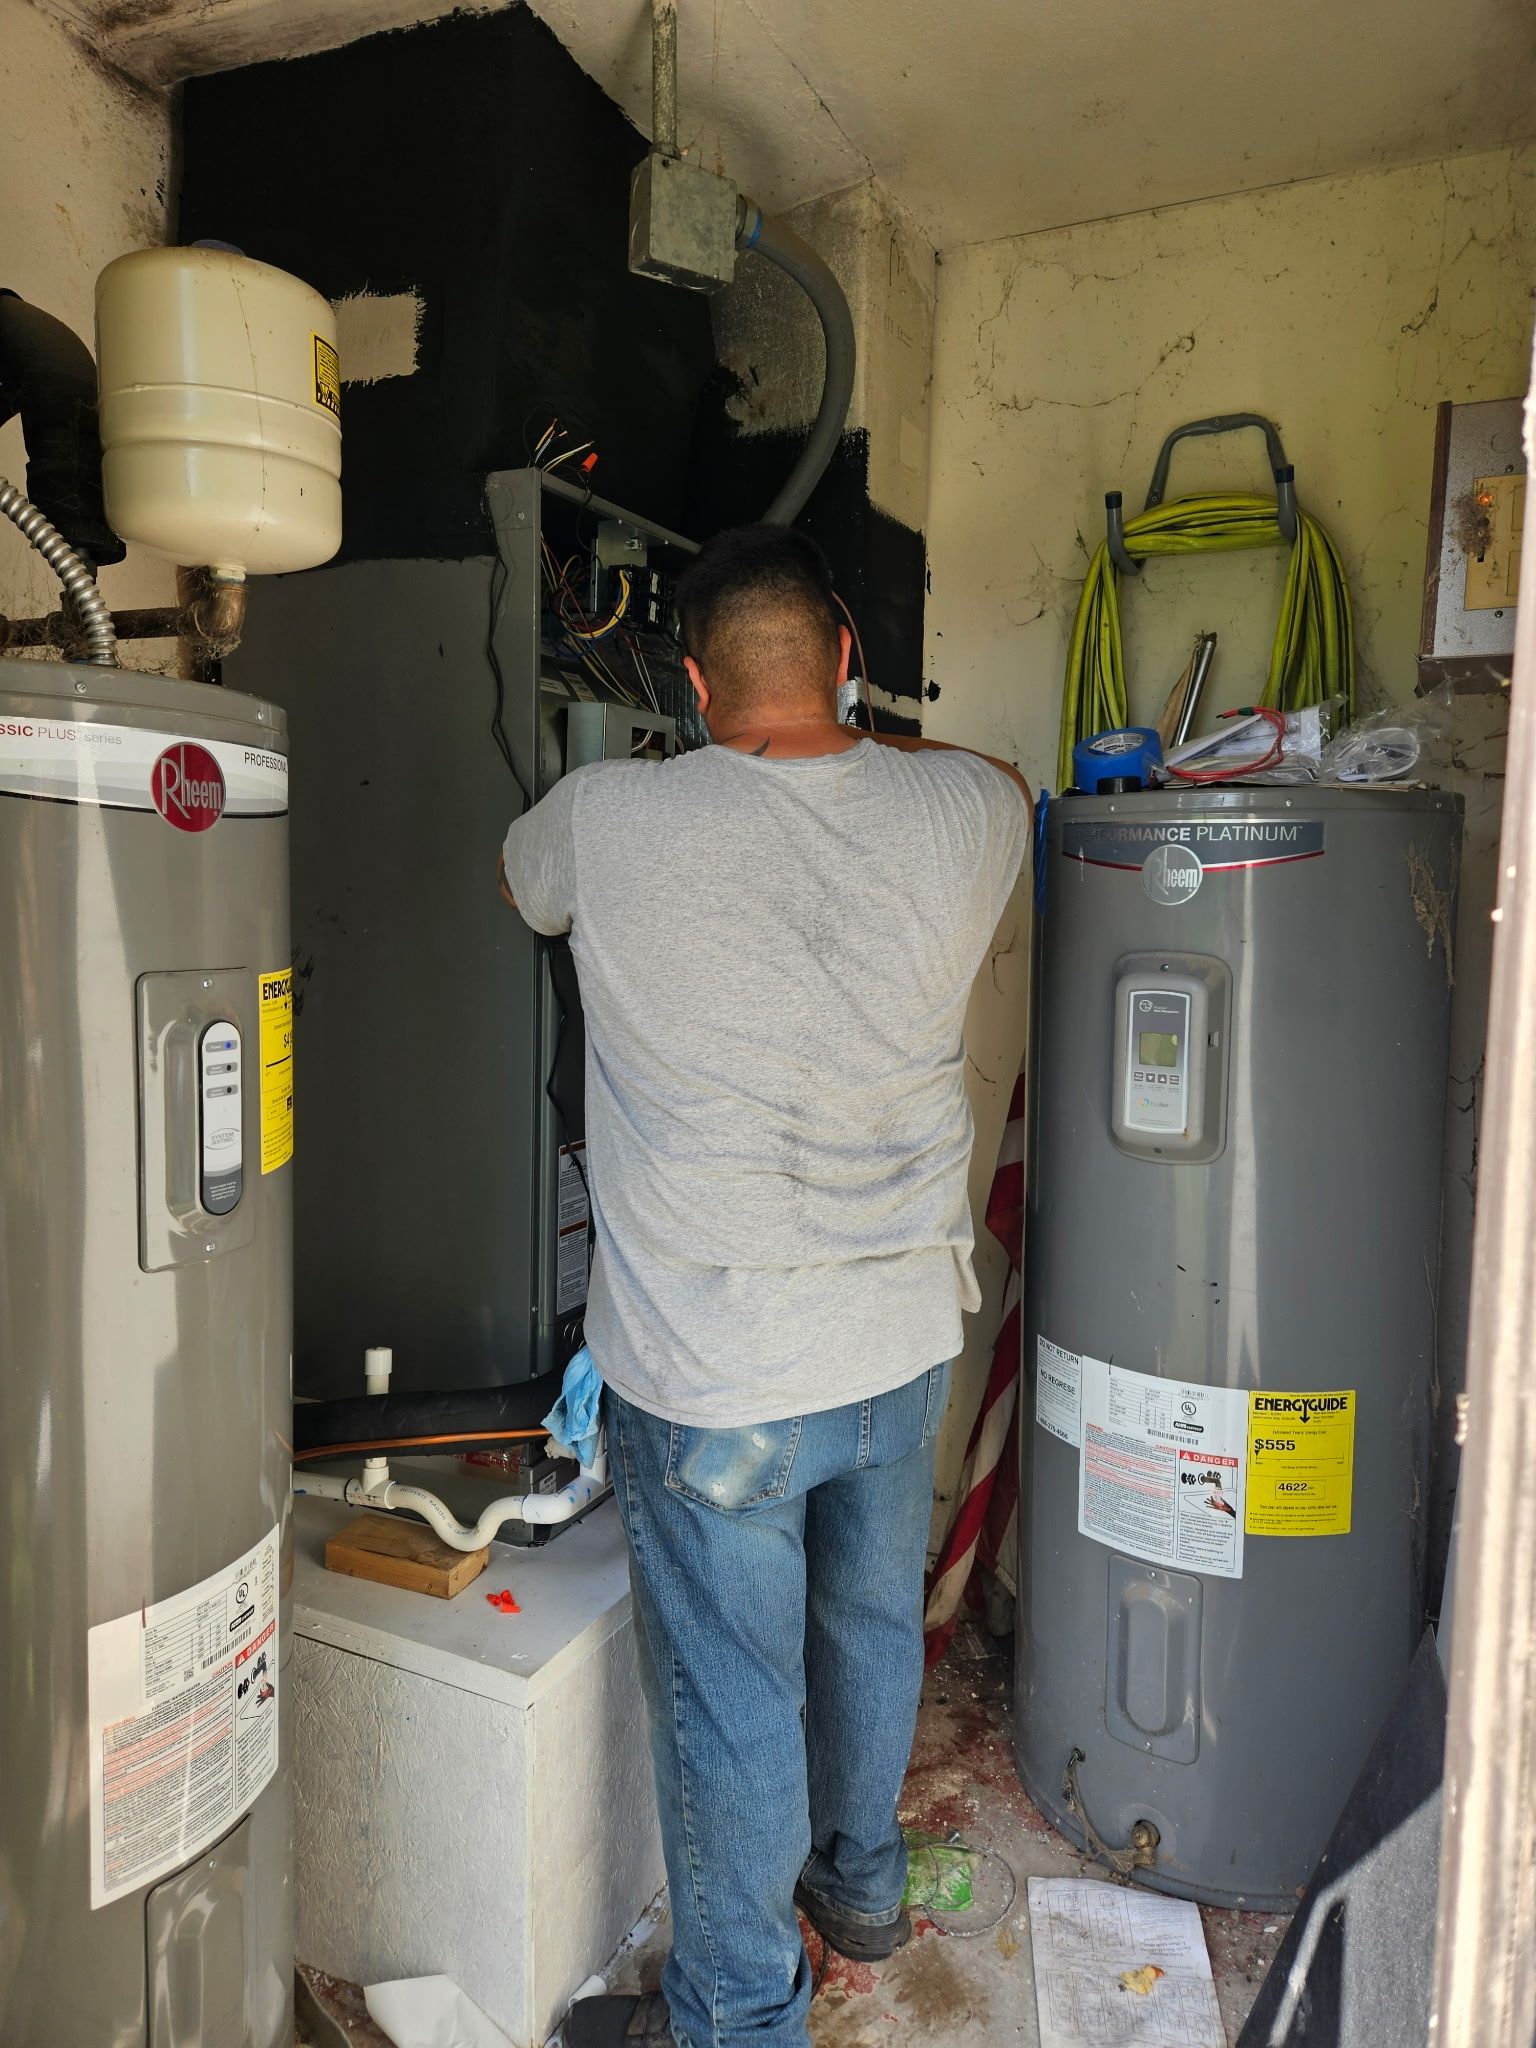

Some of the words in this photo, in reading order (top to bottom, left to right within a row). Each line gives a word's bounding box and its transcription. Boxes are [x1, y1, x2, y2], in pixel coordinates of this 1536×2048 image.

[38, 726, 77, 741] PLUS
[84, 732, 122, 745] series
[161, 745, 222, 819] Rheem
[1197, 825, 1297, 841] PLATINUM
[1149, 847, 1198, 895] Rheem
[1056, 1347, 1079, 1365] RETURN
[1255, 1397, 1348, 1412] ENERGYGUIDE
[1254, 1438, 1296, 1451] $555
[1193, 1453, 1236, 1467] DANGER
[1278, 1482, 1308, 1491] 4622
[246, 1622, 276, 1660] DANGER
